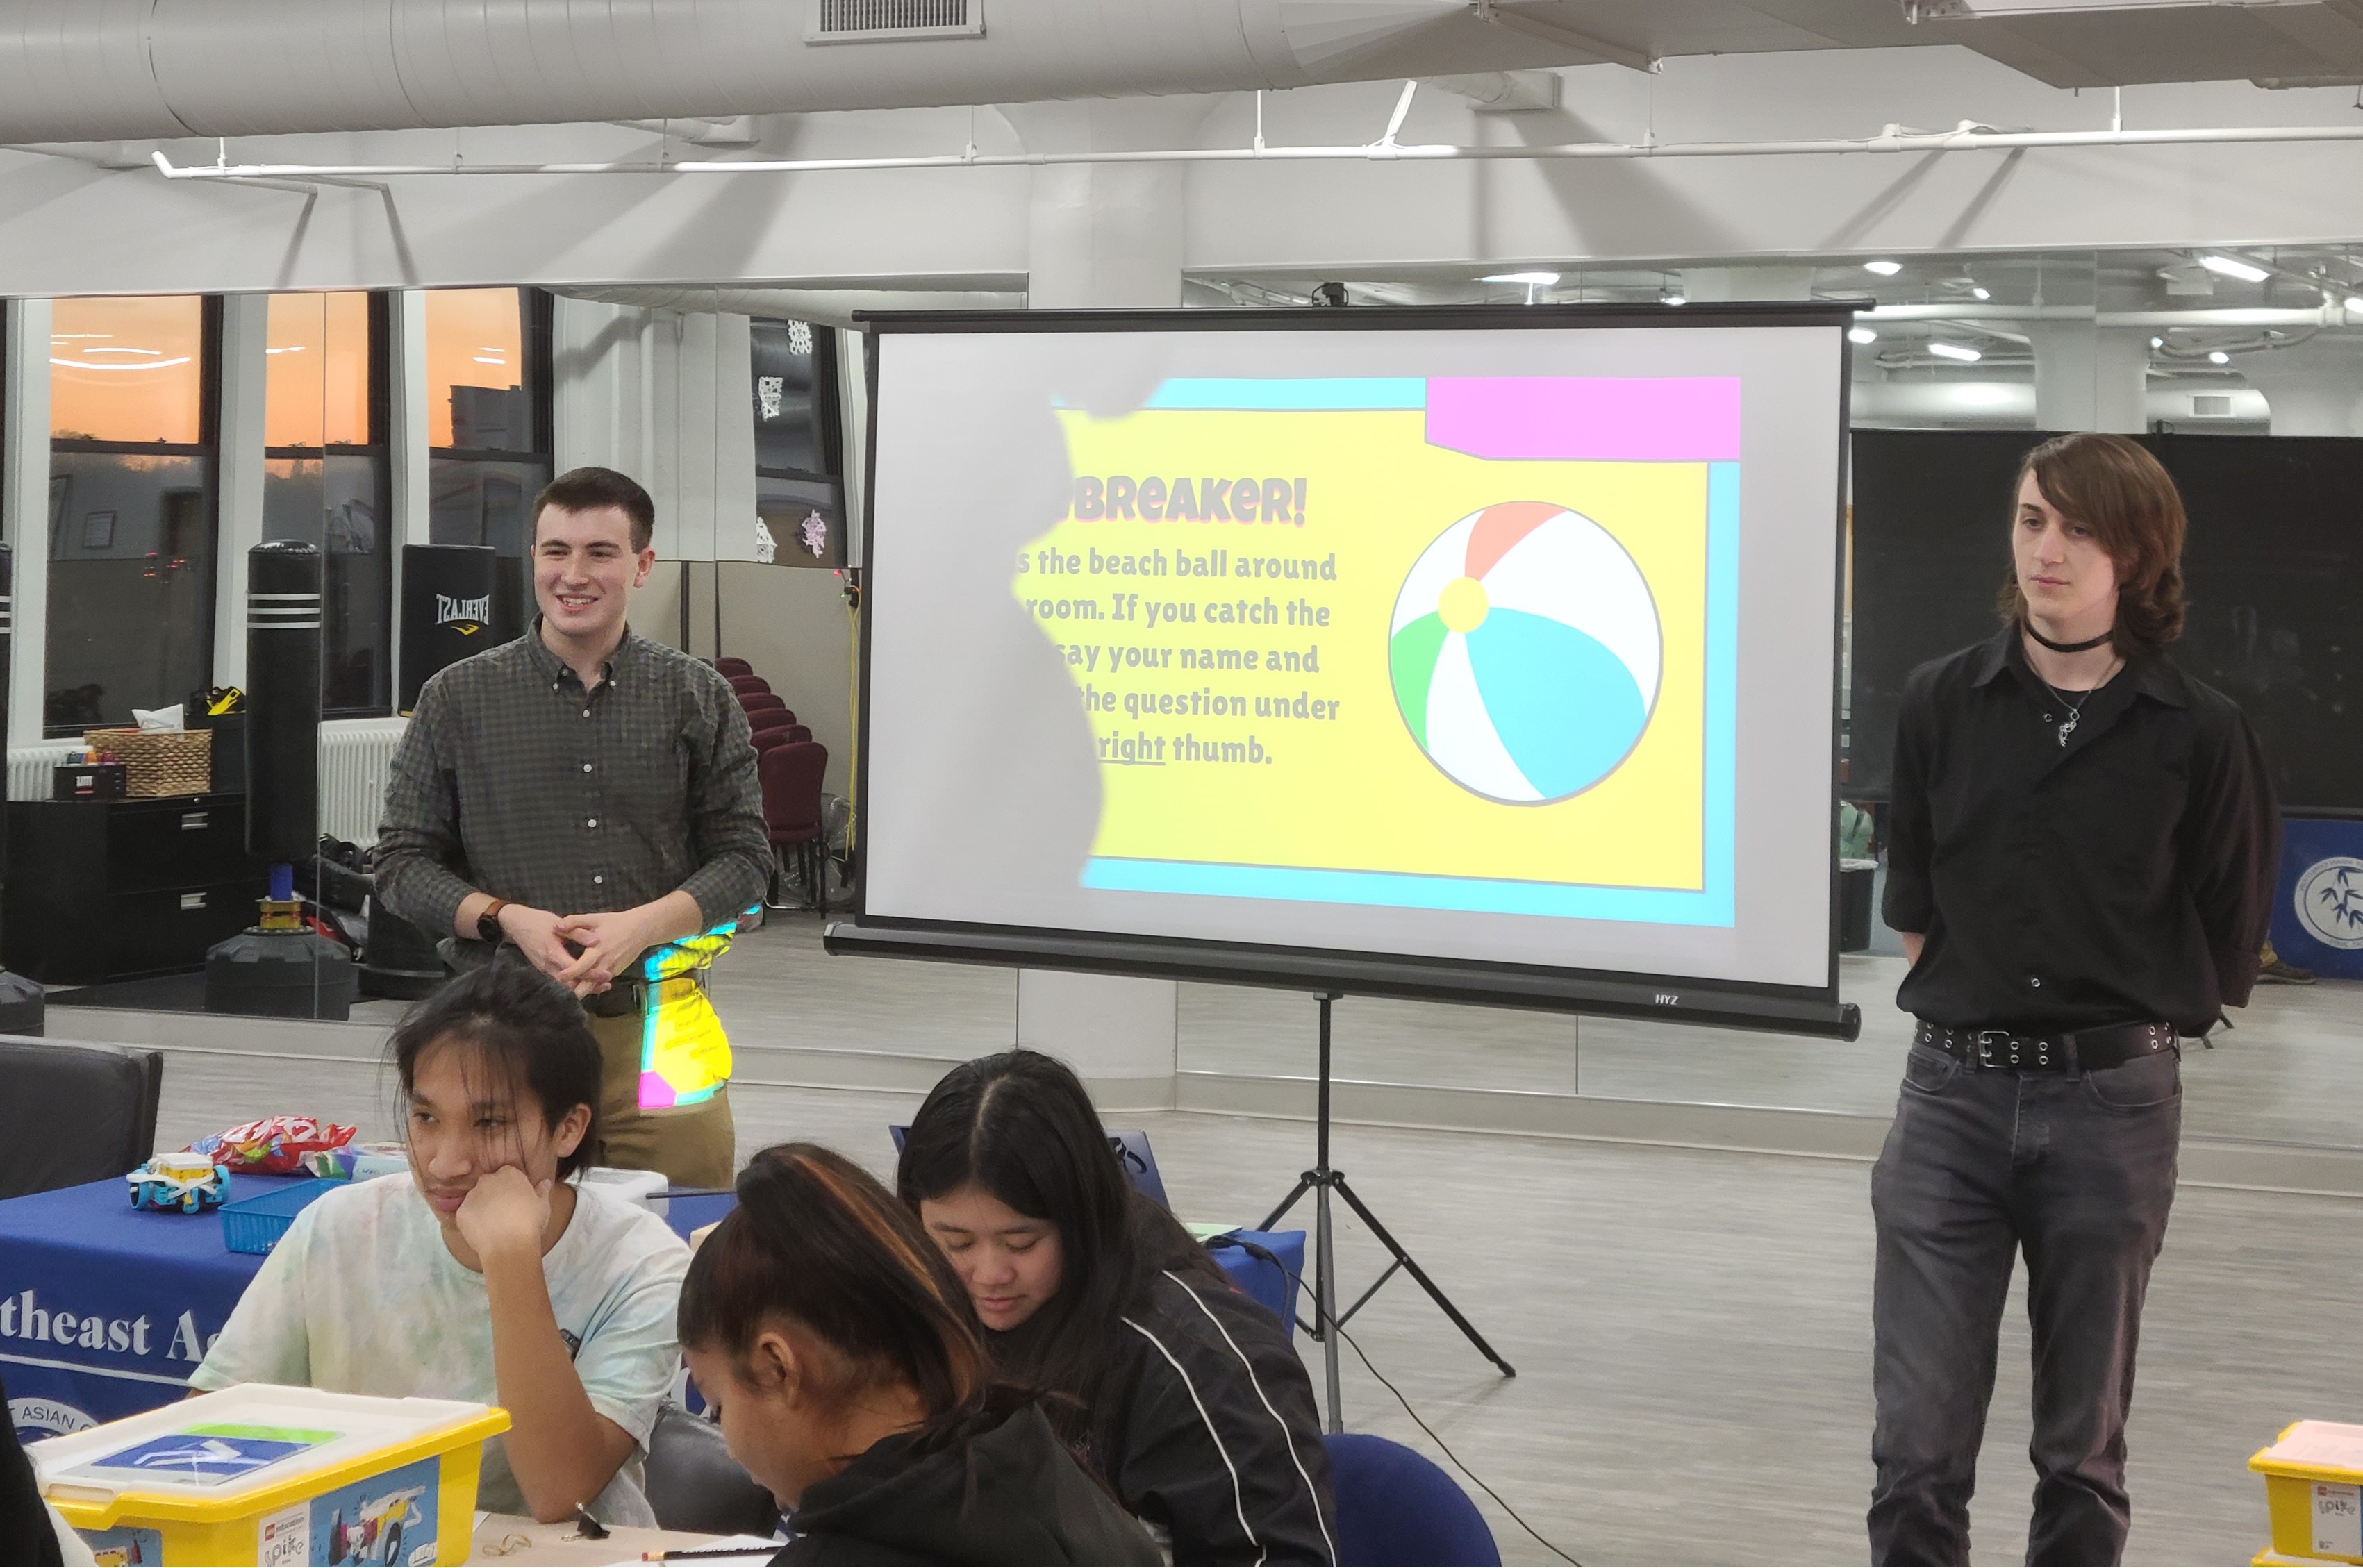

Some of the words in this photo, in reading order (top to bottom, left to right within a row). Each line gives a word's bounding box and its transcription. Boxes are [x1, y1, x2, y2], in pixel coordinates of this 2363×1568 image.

[1038, 547, 1081, 574] the
[1089, 547, 1168, 576] beach
[1176, 549, 1227, 577] ball
[1235, 553, 1337, 581] around
[1026, 599, 1105, 620] room.
[1112, 593, 1139, 621] If
[1145, 601, 1197, 628] you
[1204, 597, 1279, 625] catch
[1286, 598, 1331, 627] the
[1108, 646, 1173, 674] your
[1179, 648, 1259, 670] name
[1266, 644, 1320, 673] and
[1124, 687, 1246, 720] question
[1255, 691, 1340, 720] under
[1098, 731, 1166, 765] right
[1172, 733, 1272, 764] thumb.
[1655, 994, 1679, 1005] HYZ
[22, 1406, 75, 1429] ASIAN
